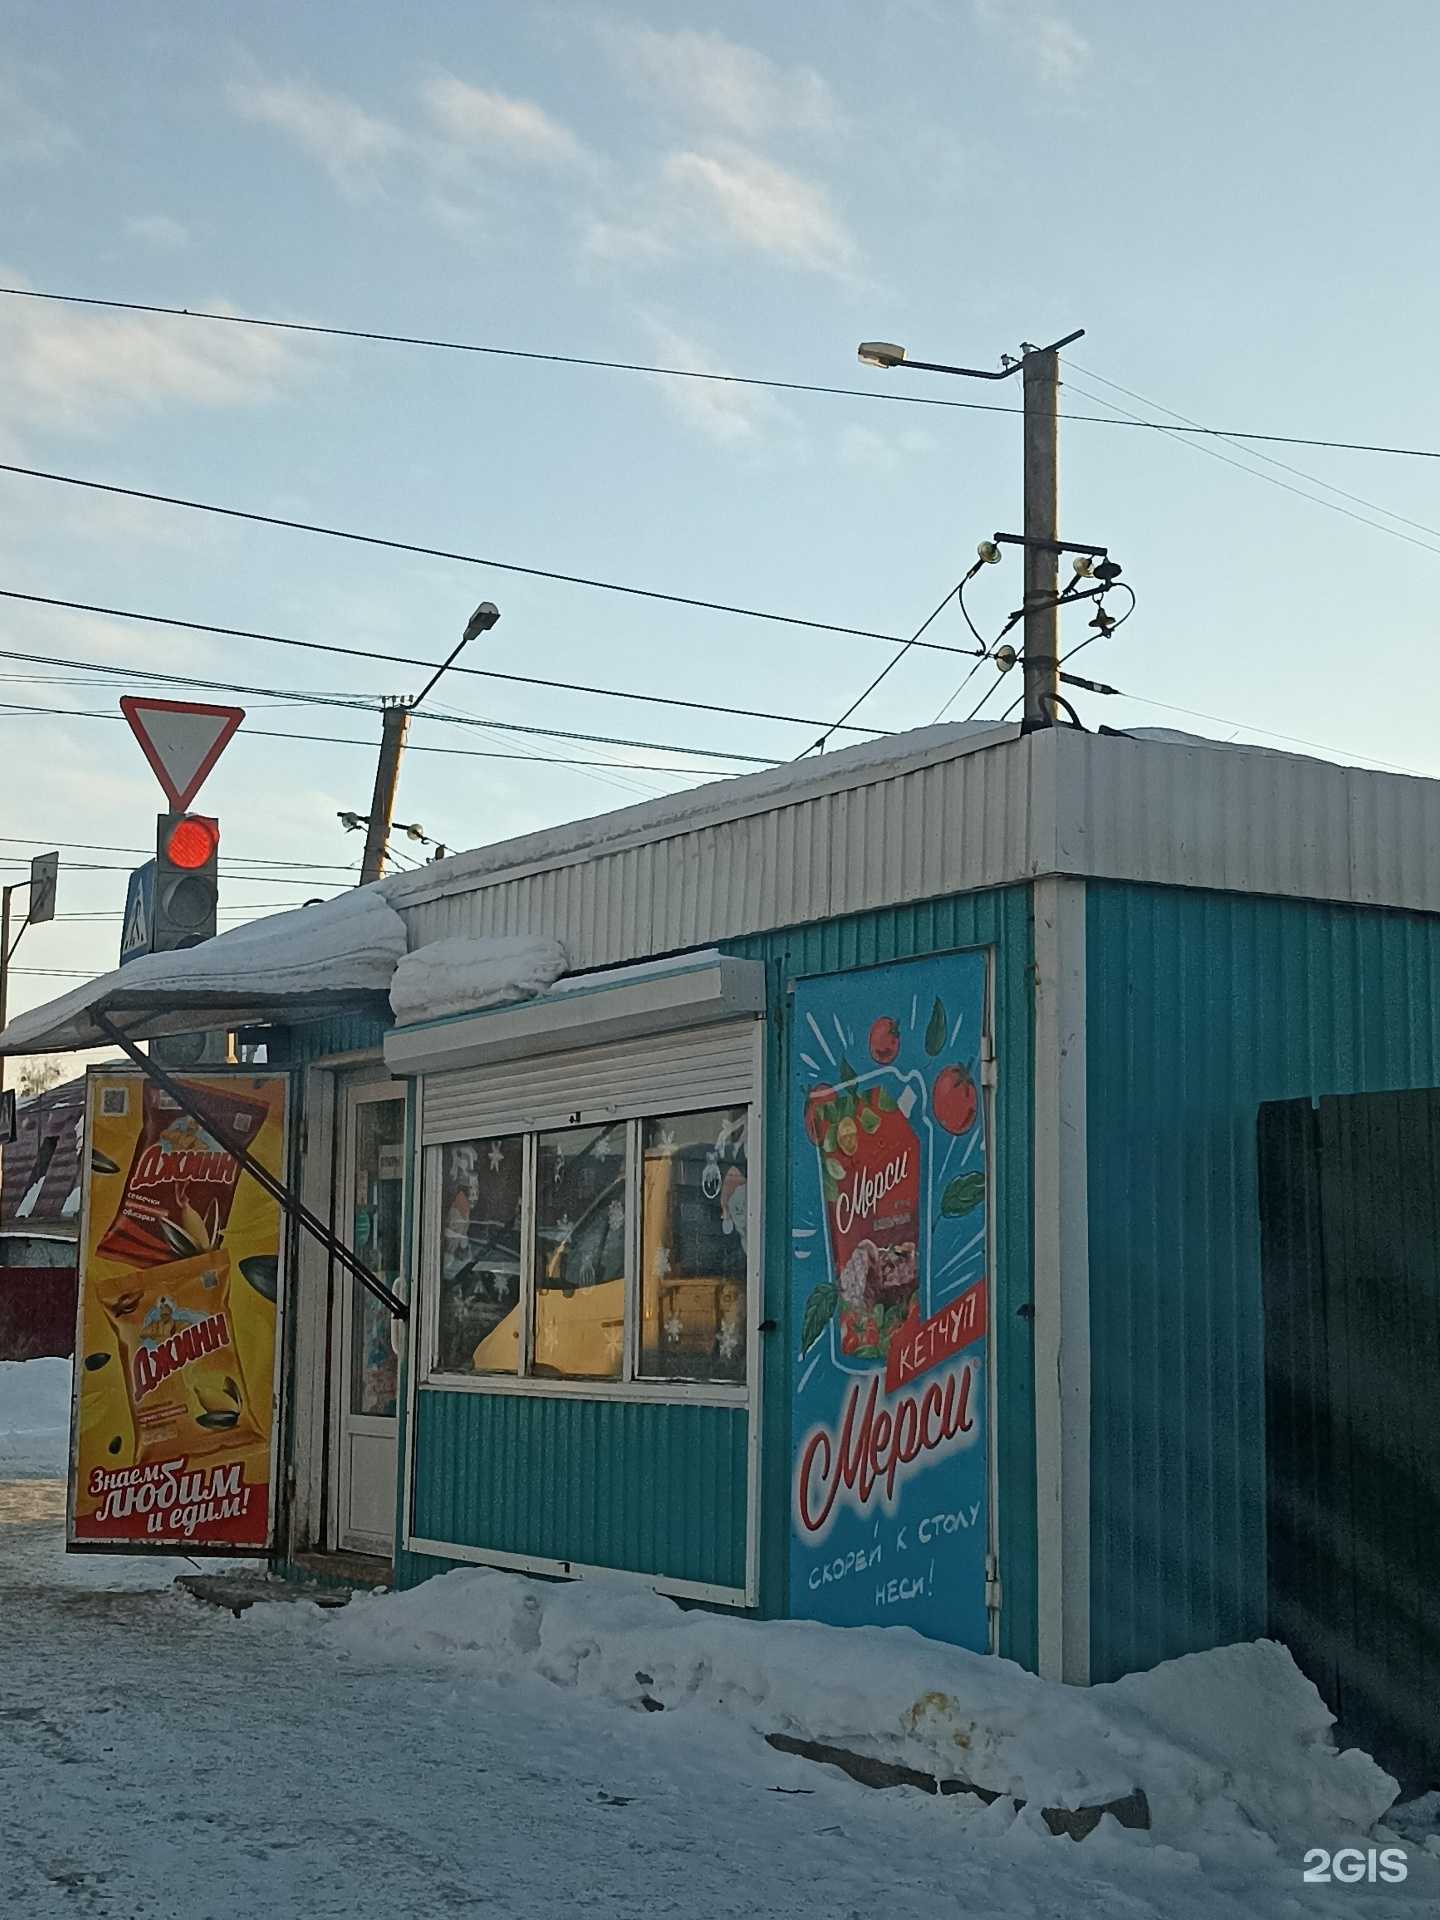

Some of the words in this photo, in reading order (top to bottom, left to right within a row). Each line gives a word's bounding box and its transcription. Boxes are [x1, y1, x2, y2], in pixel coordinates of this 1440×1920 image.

[836, 1151, 908, 1234] Мерси
[900, 1293, 977, 1378] КЕТЧУП
[96, 1458, 242, 1521] любим
[800, 1365, 973, 1531] Мерси
[147, 1511, 163, 1533] и
[169, 1488, 250, 1536] едим!
[808, 1519, 882, 1590] СКОРЕЙ
[896, 1526, 907, 1550] К
[918, 1501, 981, 1544] СТОЛУ
[874, 1558, 935, 1607] НЕСИ!
